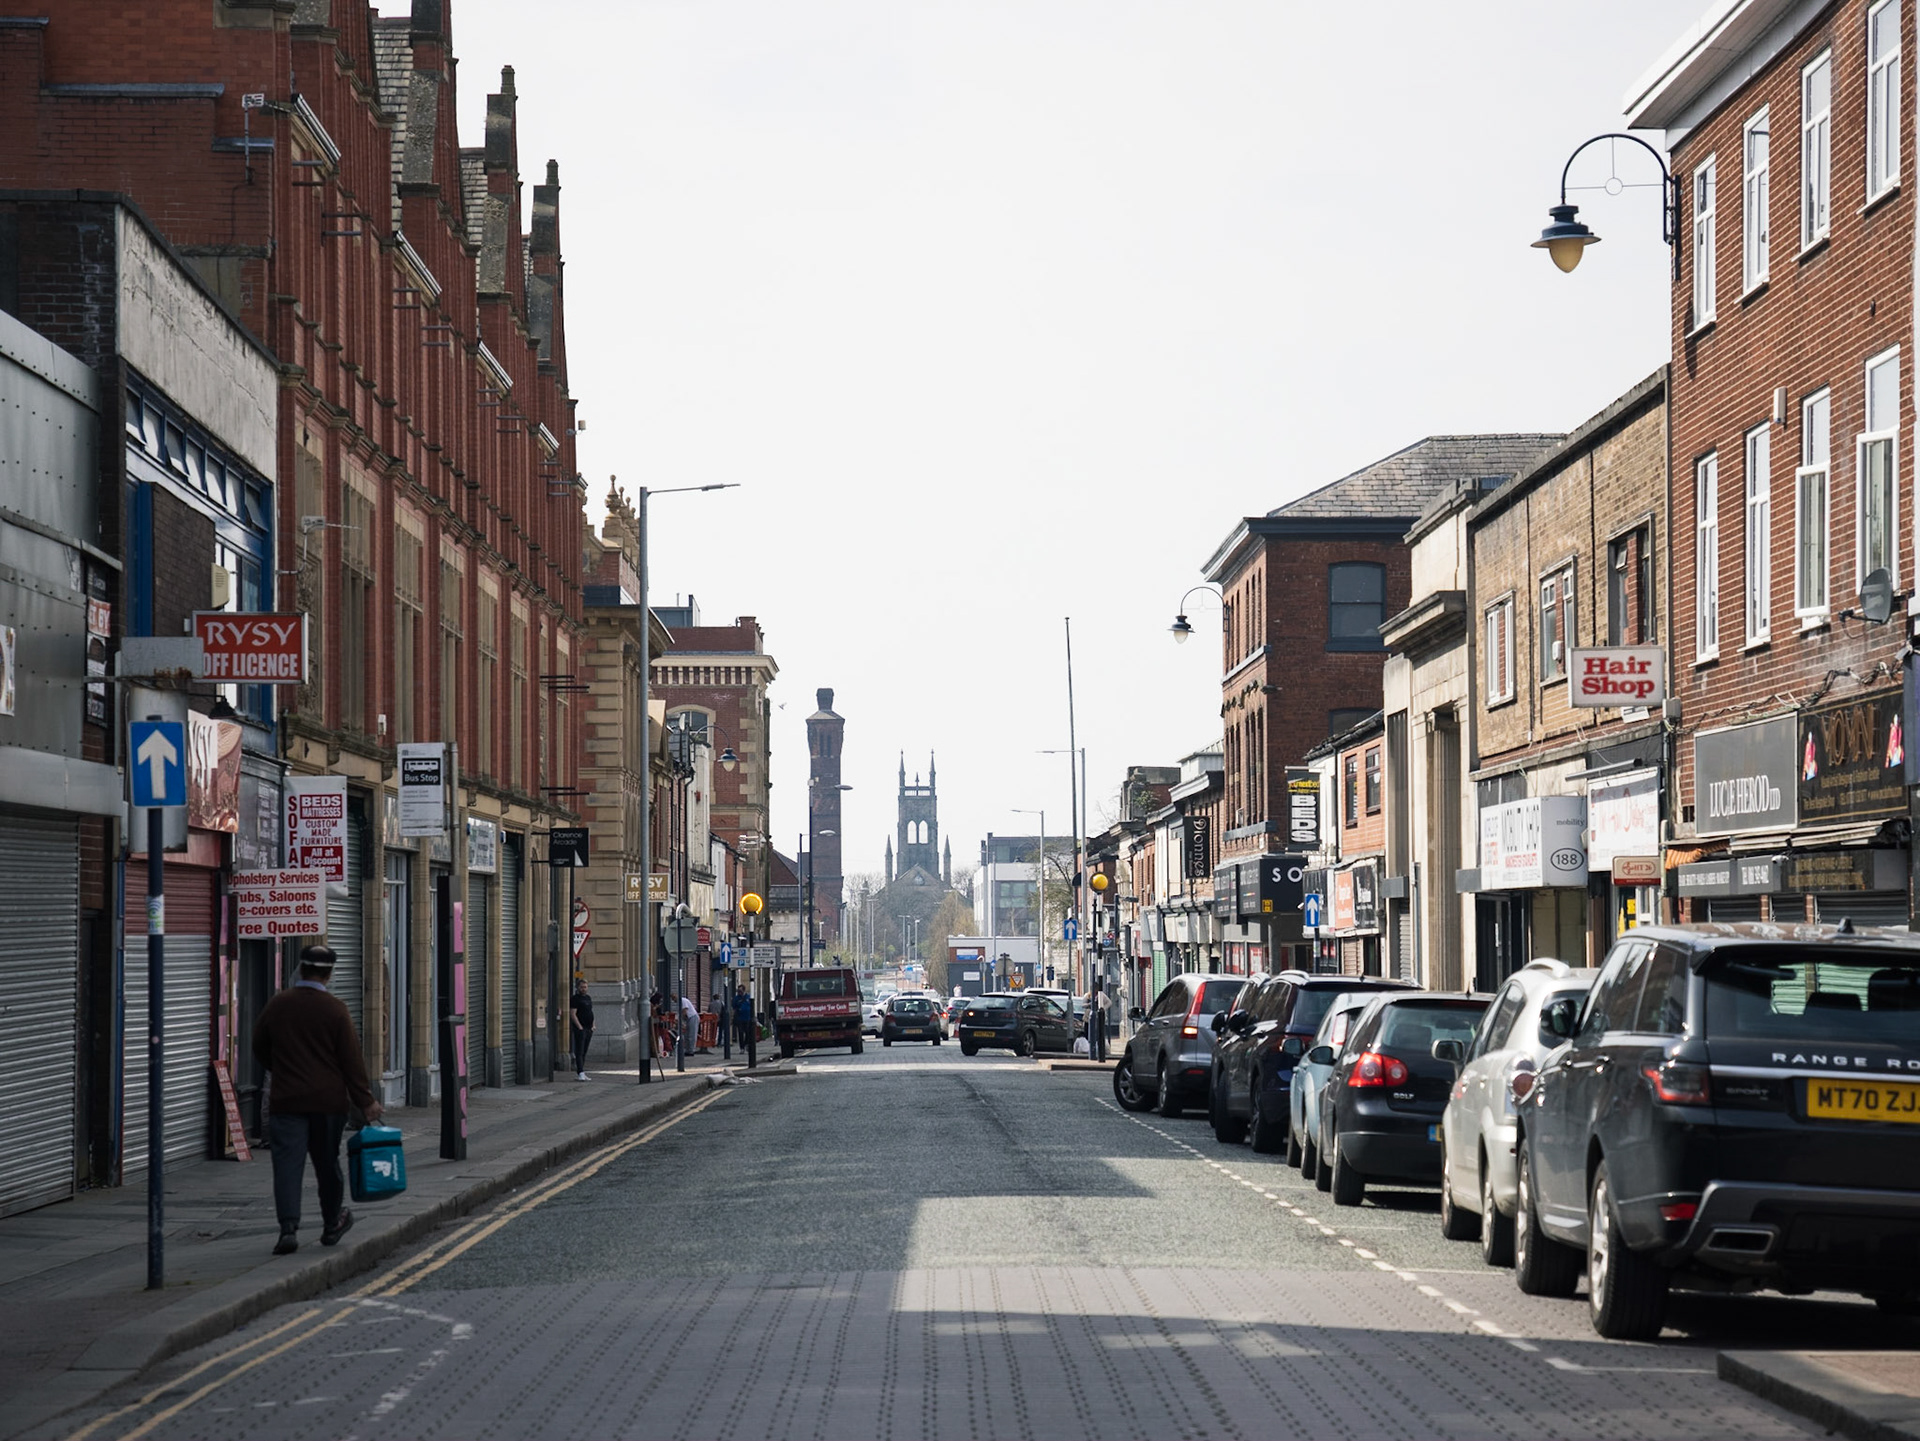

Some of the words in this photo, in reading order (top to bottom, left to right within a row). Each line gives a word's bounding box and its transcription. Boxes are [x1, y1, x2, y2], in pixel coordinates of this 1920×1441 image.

[204, 621, 297, 646] RYSY
[203, 652, 229, 676] OFF
[232, 653, 298, 677] LICENCE
[1583, 656, 1652, 675] Hair
[1581, 676, 1655, 698] Shop
[404, 773, 419, 782] Bus
[420, 773, 439, 783] Stop
[1736, 774, 1770, 814] HEROD
[301, 796, 341, 807] BEDS
[302, 807, 342, 818] MATTRESSES
[1291, 794, 1317, 842] BEDS
[305, 819, 338, 829] CUSTOM
[1556, 818, 1585, 826] mobility
[288, 795, 298, 869] SOFA
[311, 829, 332, 837] MADE
[301, 836, 343, 845] FURNITURE
[311, 848, 324, 858] All
[326, 848, 334, 857] at
[1556, 853, 1578, 866] 188
[304, 856, 342, 867] Discount
[279, 871, 319, 885] Services
[630, 876, 663, 888] RSY
[232, 891, 265, 904] ubs,
[269, 890, 316, 902] Saloons
[239, 906, 291, 916] e-covers
[295, 903, 318, 915] etc.
[238, 923, 262, 934] ree
[267, 921, 319, 935] Quotes
[1772, 1053, 1868, 1067] RANGE
[1818, 1086, 1879, 1110] MT70
[1886, 1091, 1920, 1113] ZJ
